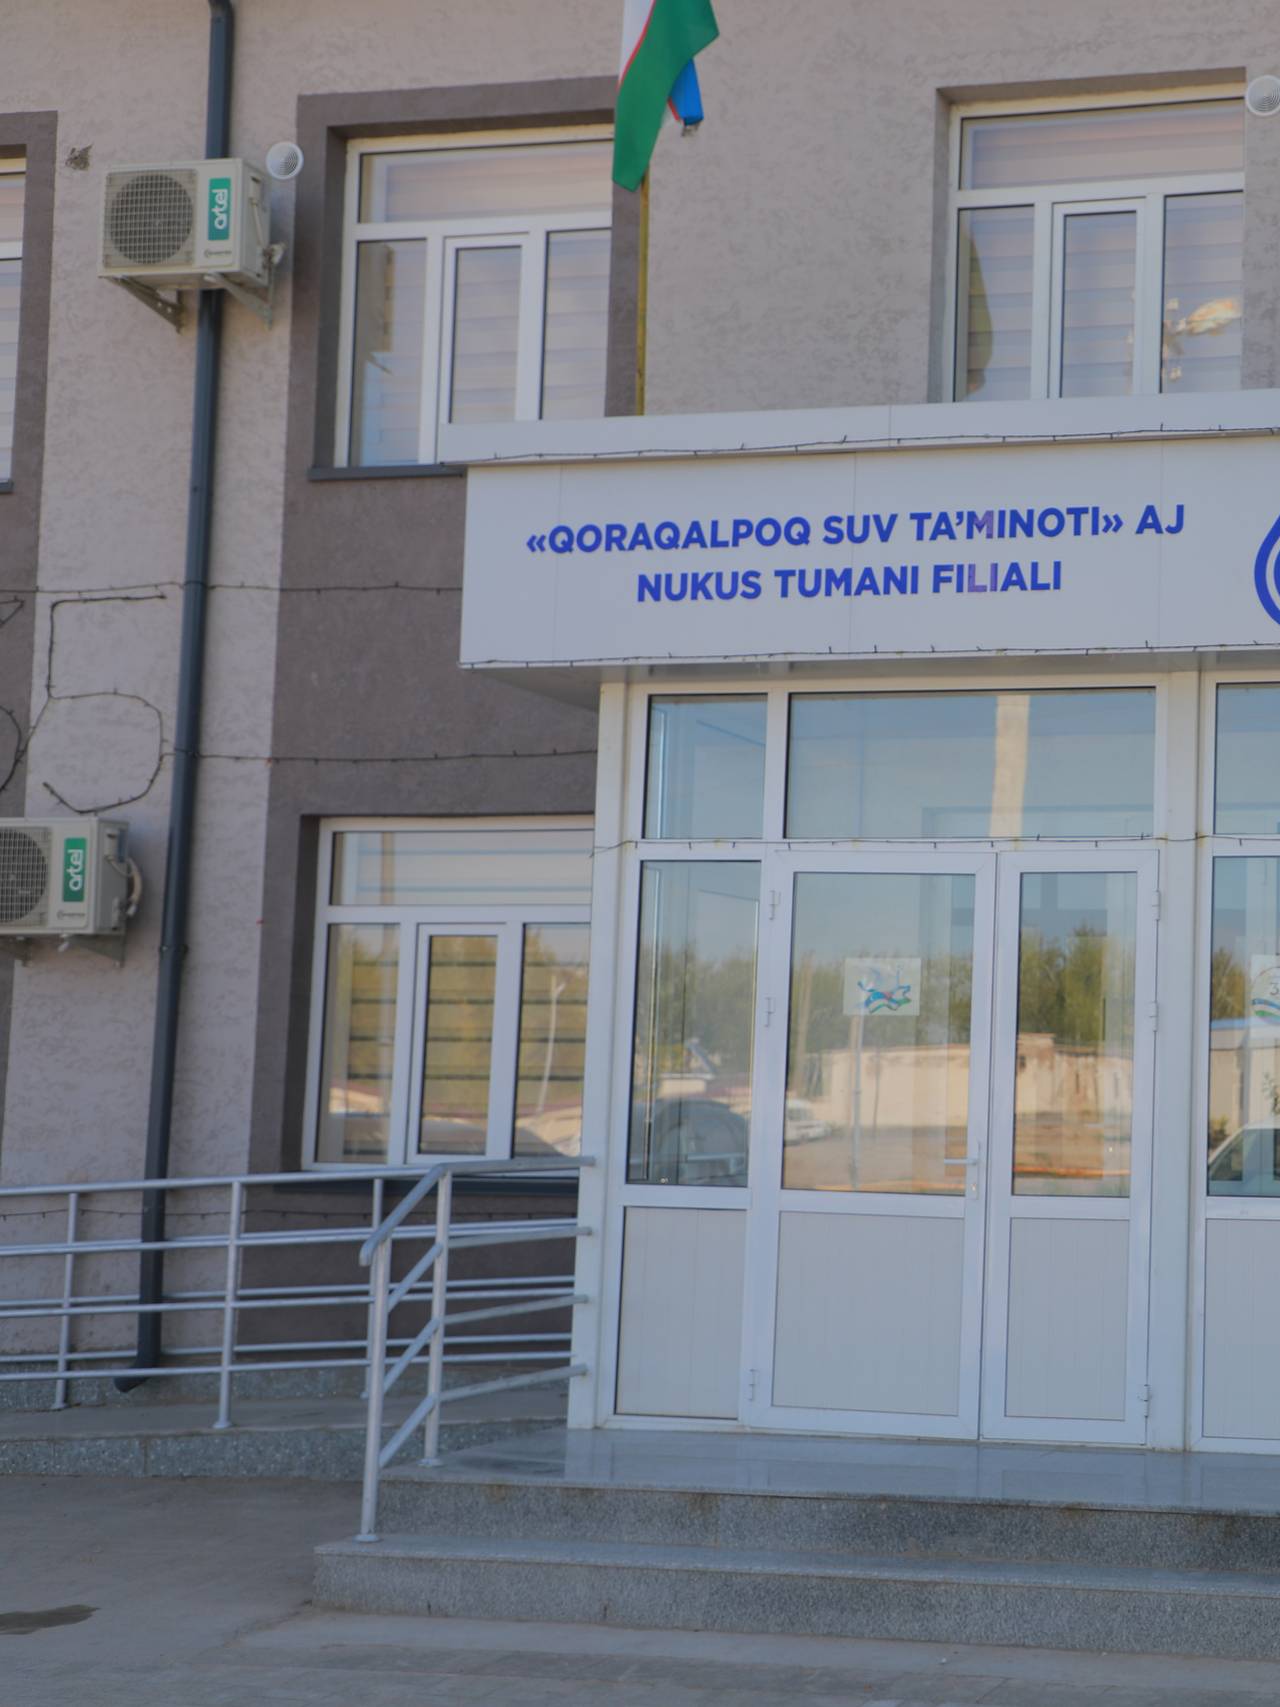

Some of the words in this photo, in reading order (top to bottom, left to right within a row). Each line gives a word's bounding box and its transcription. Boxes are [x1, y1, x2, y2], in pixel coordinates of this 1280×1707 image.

[212, 188, 229, 230] artel
[526, 516, 812, 554] «QORAQALPOQ
[822, 513, 899, 545] SUV
[908, 505, 1125, 542] TA’MINOTI»
[1135, 504, 1185, 535] AJ
[636, 569, 762, 603] NUKUS
[772, 563, 920, 600] TUMANI
[931, 559, 1063, 594] FILIALI
[66, 848, 84, 892] artel
